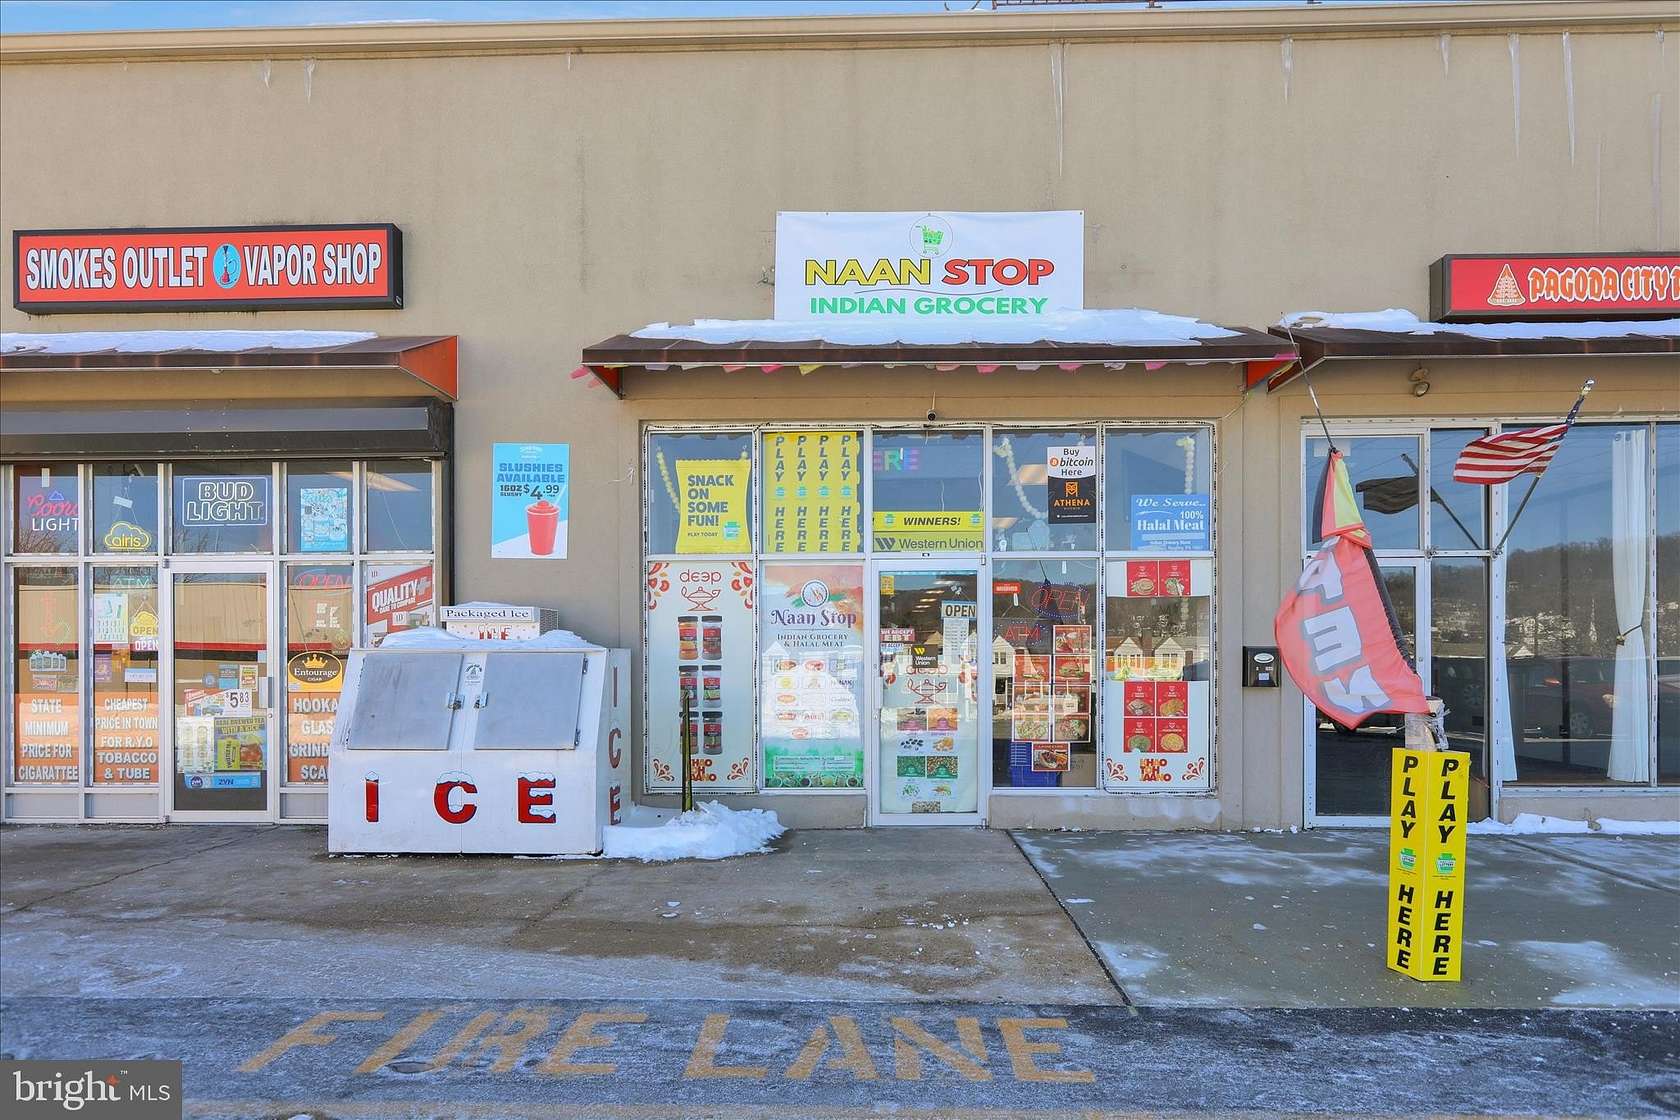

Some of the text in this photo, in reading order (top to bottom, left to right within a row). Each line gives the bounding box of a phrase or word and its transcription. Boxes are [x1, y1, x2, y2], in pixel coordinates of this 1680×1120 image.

[26, 242, 383, 290] SMOKES OUTLET VAPOR SHOP
[804, 258, 1055, 286] NAAN STOP
[1528, 266, 1619, 303] PAGODA
[1620, 265, 1670, 301] CITY
[810, 296, 1048, 315] INDIAN GROCERY
[1063, 448, 1080, 456] Buy
[499, 463, 563, 473] SLUSHIES
[1060, 457, 1094, 467] bitcoin
[496, 473, 566, 483] AVAILABLE
[1061, 468, 1083, 476] Here
[687, 474, 734, 486] SNACK
[199, 481, 254, 501] BUD
[687, 488, 710, 500] ON
[774, 435, 785, 552] PLAY HERE
[797, 435, 808, 552] PLAY HERE
[819, 435, 829, 552] PLAY HERE
[841, 435, 851, 552] PLAY HERE
[687, 501, 728, 513] SOME
[1054, 499, 1091, 507] ATHENA
[1136, 497, 1160, 507] We
[187, 501, 264, 521] LIGHT
[1180, 510, 1204, 519] 100%
[32, 518, 79, 531] LIGHT
[687, 514, 719, 526] FUN!
[903, 517, 961, 526] WINNERS!
[1137, 519, 1204, 531] Halal Meat
[899, 538, 983, 549] Western Union
[372, 579, 419, 613] QUALITY
[446, 609, 529, 619] Packaged Ice
[945, 604, 976, 617] OPEN
[770, 609, 857, 628] Naan Stop
[777, 633, 849, 641] INDIAN GROCERY
[134, 640, 159, 651] OPEN
[294, 667, 338, 678] Entourage
[31, 698, 62, 713] STATE
[104, 698, 148, 711] CHEAPEST
[294, 698, 338, 714] HOOKA
[25, 720, 69, 735] MINIMUM
[95, 716, 158, 729] PRICE IN TOWN
[301, 720, 335, 735] GLAS
[101, 736, 123, 748] FOR
[608, 666, 622, 826] ICE
[22, 743, 72, 758] PRICE FOR
[290, 742, 330, 758] GRIND
[97, 752, 157, 764] TOBACCO
[19, 765, 79, 780] CIGARATTEE
[104, 767, 150, 779] & TUBE
[301, 765, 328, 780] SCA
[364, 770, 557, 825] ICE
[1400, 755, 1419, 839] PLAY
[1438, 758, 1460, 844] PLAY
[1396, 884, 1415, 970] HERE
[1432, 890, 1454, 976] HERE
[236, 1008, 1097, 1084] FIRE LANE
